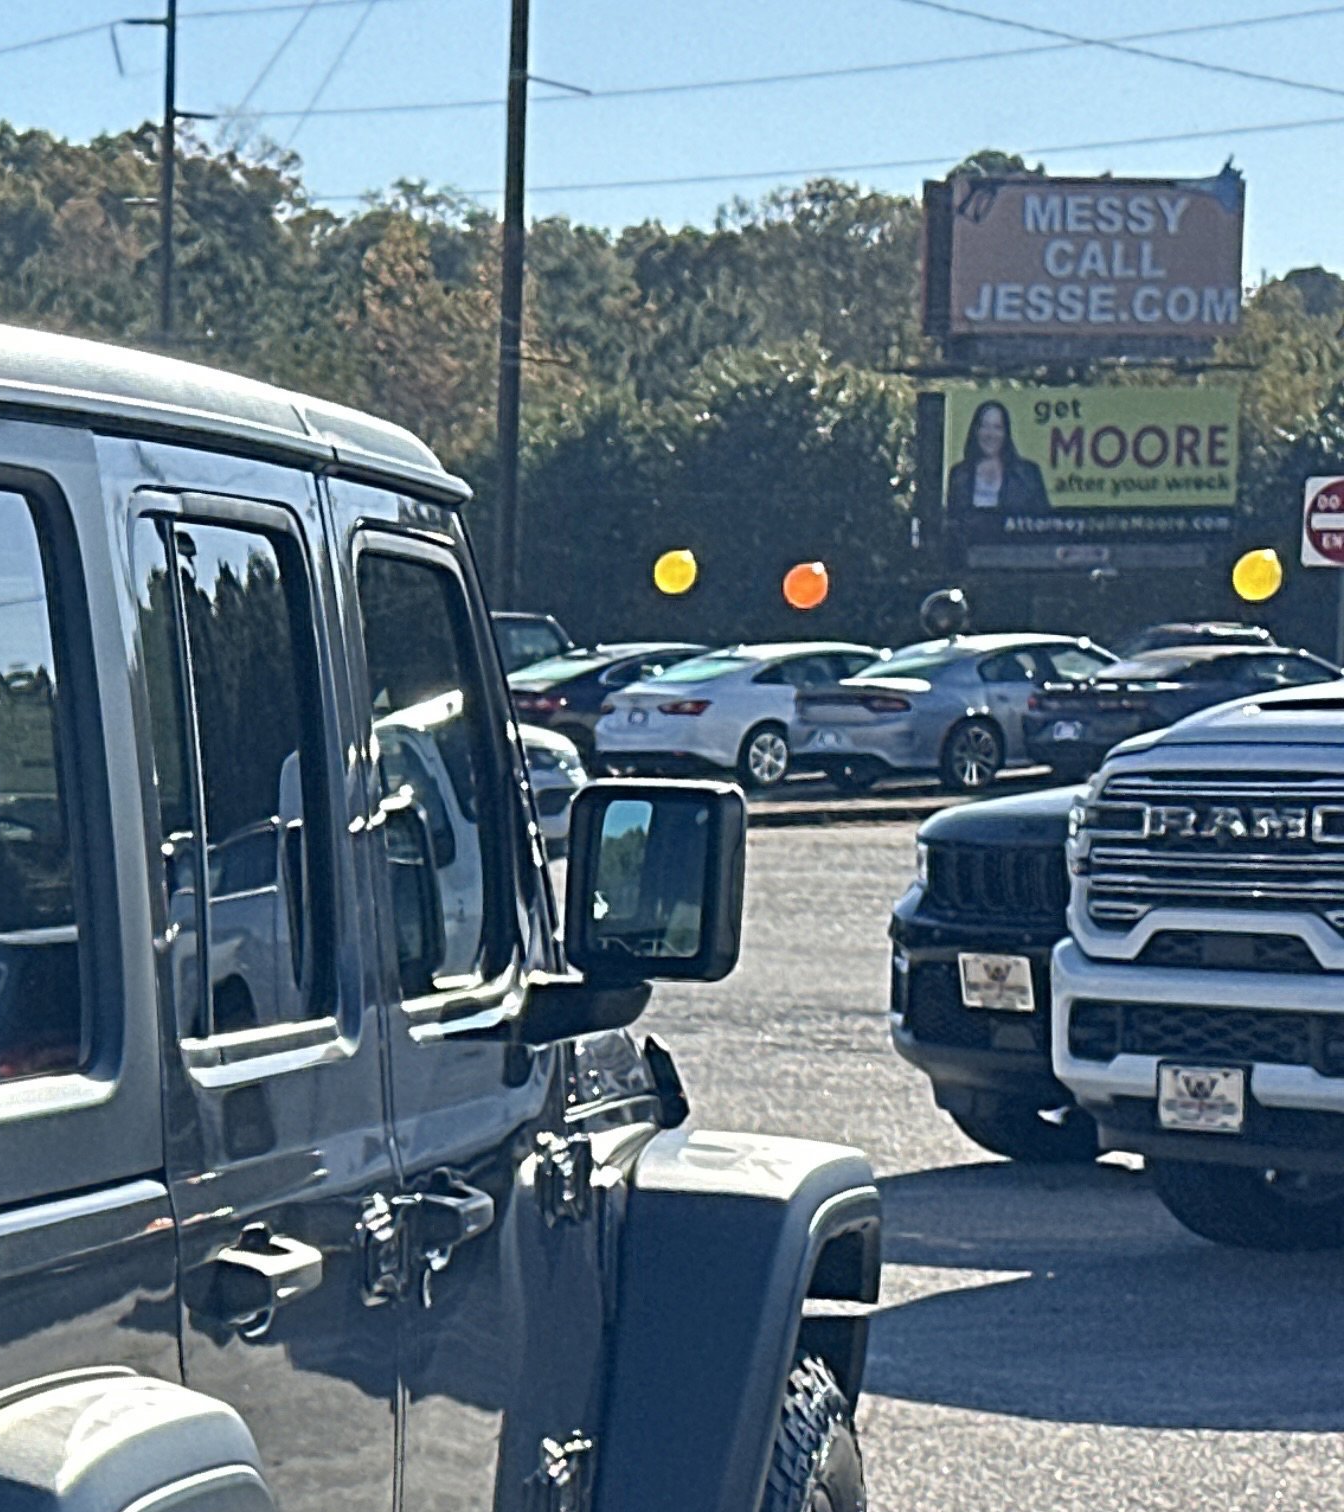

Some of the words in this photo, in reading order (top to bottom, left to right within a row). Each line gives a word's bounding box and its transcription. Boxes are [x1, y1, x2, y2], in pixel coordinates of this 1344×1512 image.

[1024, 194, 1189, 235] MESSY
[1043, 239, 1167, 279] CALL
[964, 284, 1240, 325] JESSE.COM
[1034, 398, 1082, 425] get
[1050, 425, 1230, 470] MOORE
[1054, 475, 1105, 494] after
[1111, 477, 1159, 499] your
[1165, 475, 1230, 493] wreck
[1317, 494, 1341, 512] DO
[1148, 805, 1307, 840] RAM
